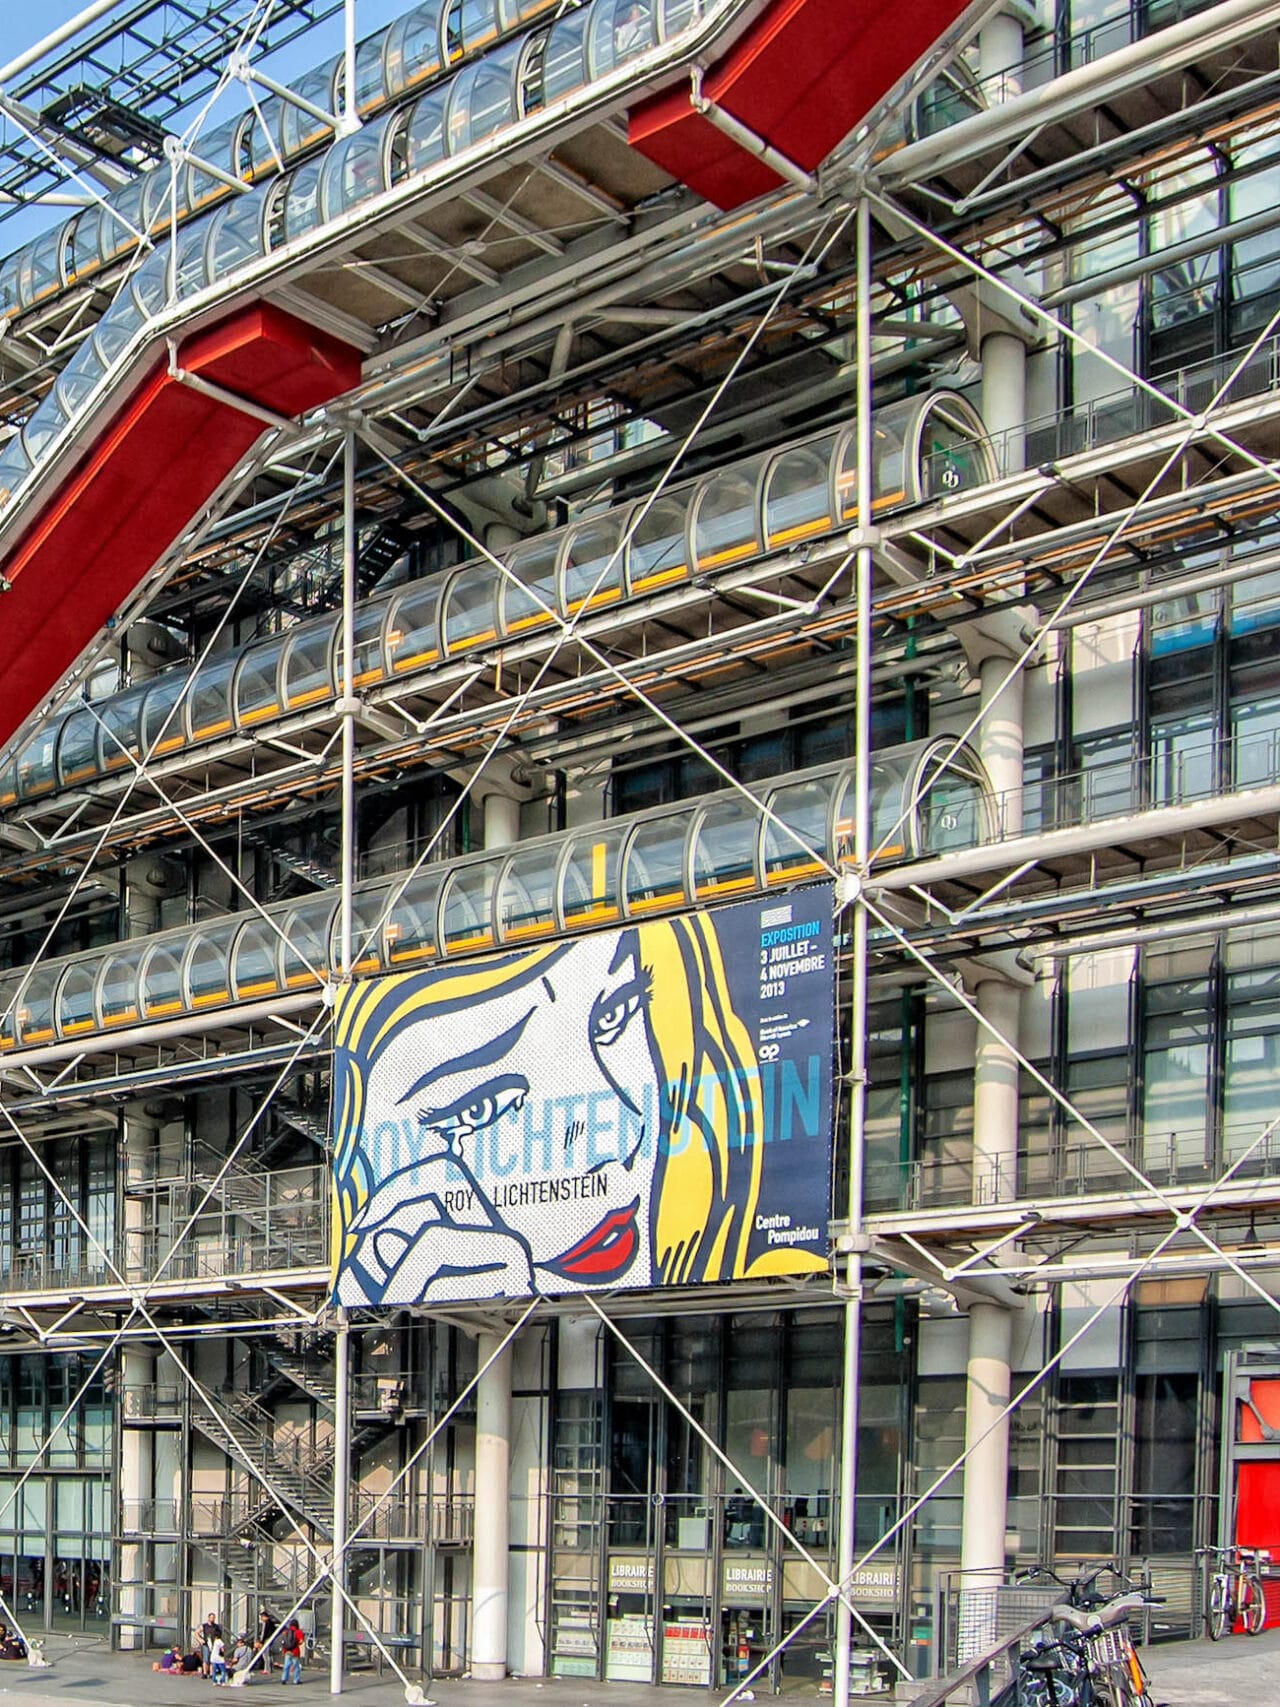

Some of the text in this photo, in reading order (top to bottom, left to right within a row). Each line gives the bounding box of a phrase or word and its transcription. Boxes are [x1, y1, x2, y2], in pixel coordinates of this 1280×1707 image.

[761, 920, 820, 947] EXPOSITION
[760, 950, 768, 964] 3
[768, 940, 810, 963] JUILLET
[760, 954, 825, 981] 4 NOVEMBRE
[760, 981, 785, 999] 2013
[445, 1055, 820, 1182] LICHTENSTEIN
[445, 1174, 608, 1212] ROY LICHTENSTEIN
[756, 1214, 790, 1230] Centre
[767, 1226, 819, 1246] Pompidou
[611, 1564, 654, 1577] LIBRAIRE
[726, 1567, 773, 1582] LIBRAIRIE
[726, 1582, 773, 1593] BOOKSHOP
